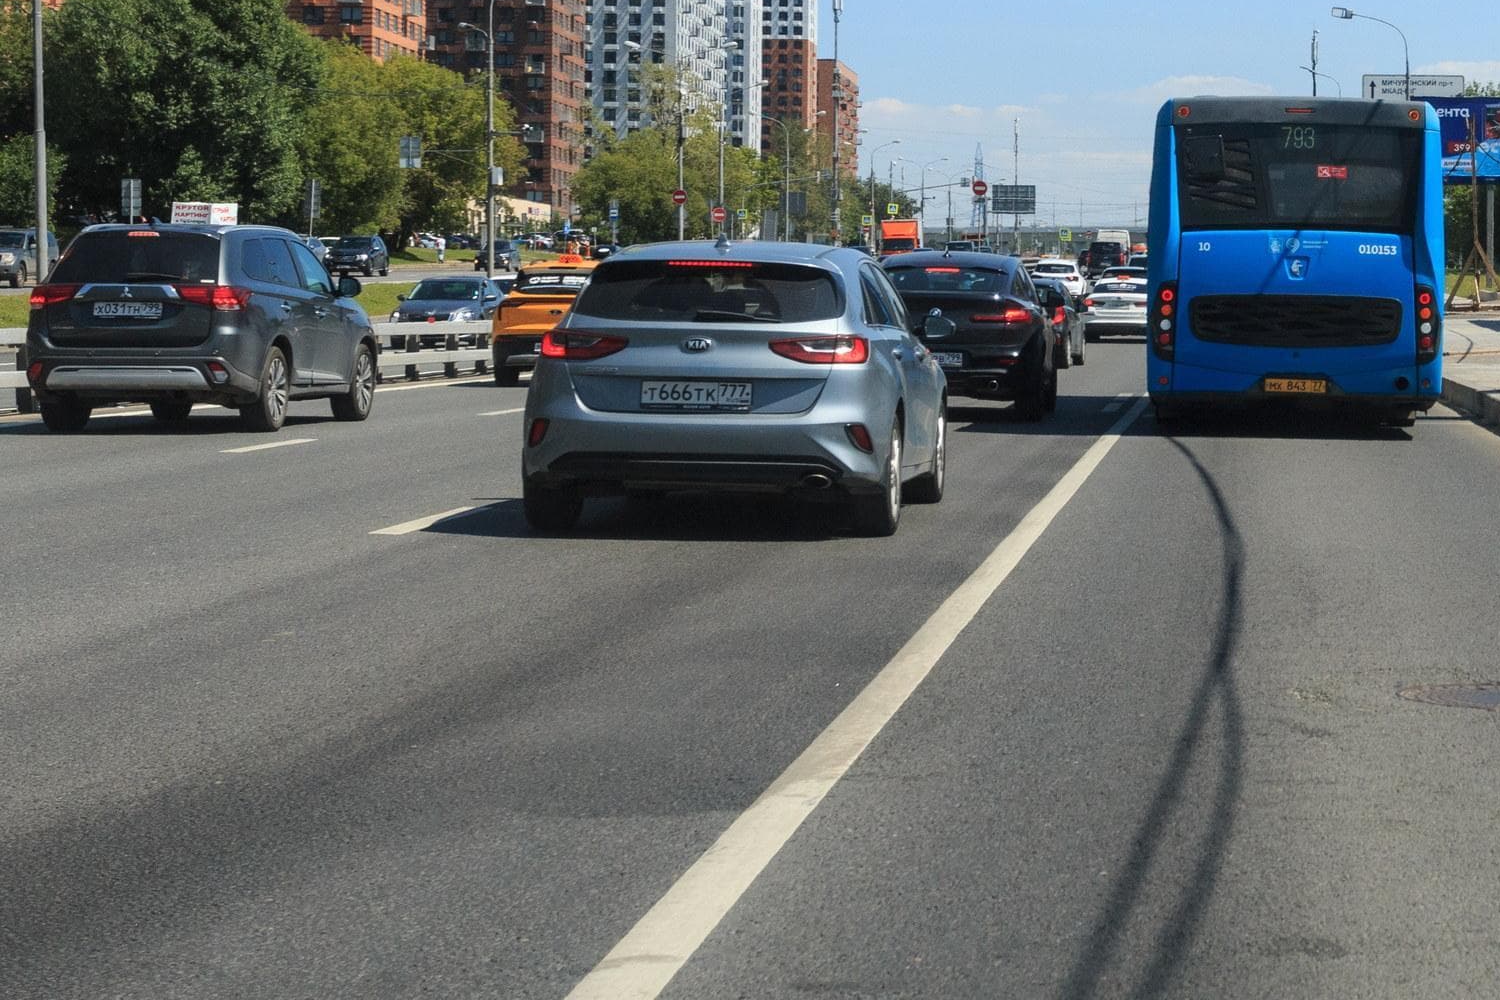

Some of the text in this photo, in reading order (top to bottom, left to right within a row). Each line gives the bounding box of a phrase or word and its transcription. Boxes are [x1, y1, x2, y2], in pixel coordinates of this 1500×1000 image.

[1436, 107, 1470, 118] ента
[1281, 127, 1315, 149] 793
[1198, 242, 1211, 251] 10
[1358, 244, 1398, 255] 010153
[688, 341, 707, 350] KIA
[1287, 381, 1306, 391] 843
[648, 384, 746, 401] Т666ТК 777
